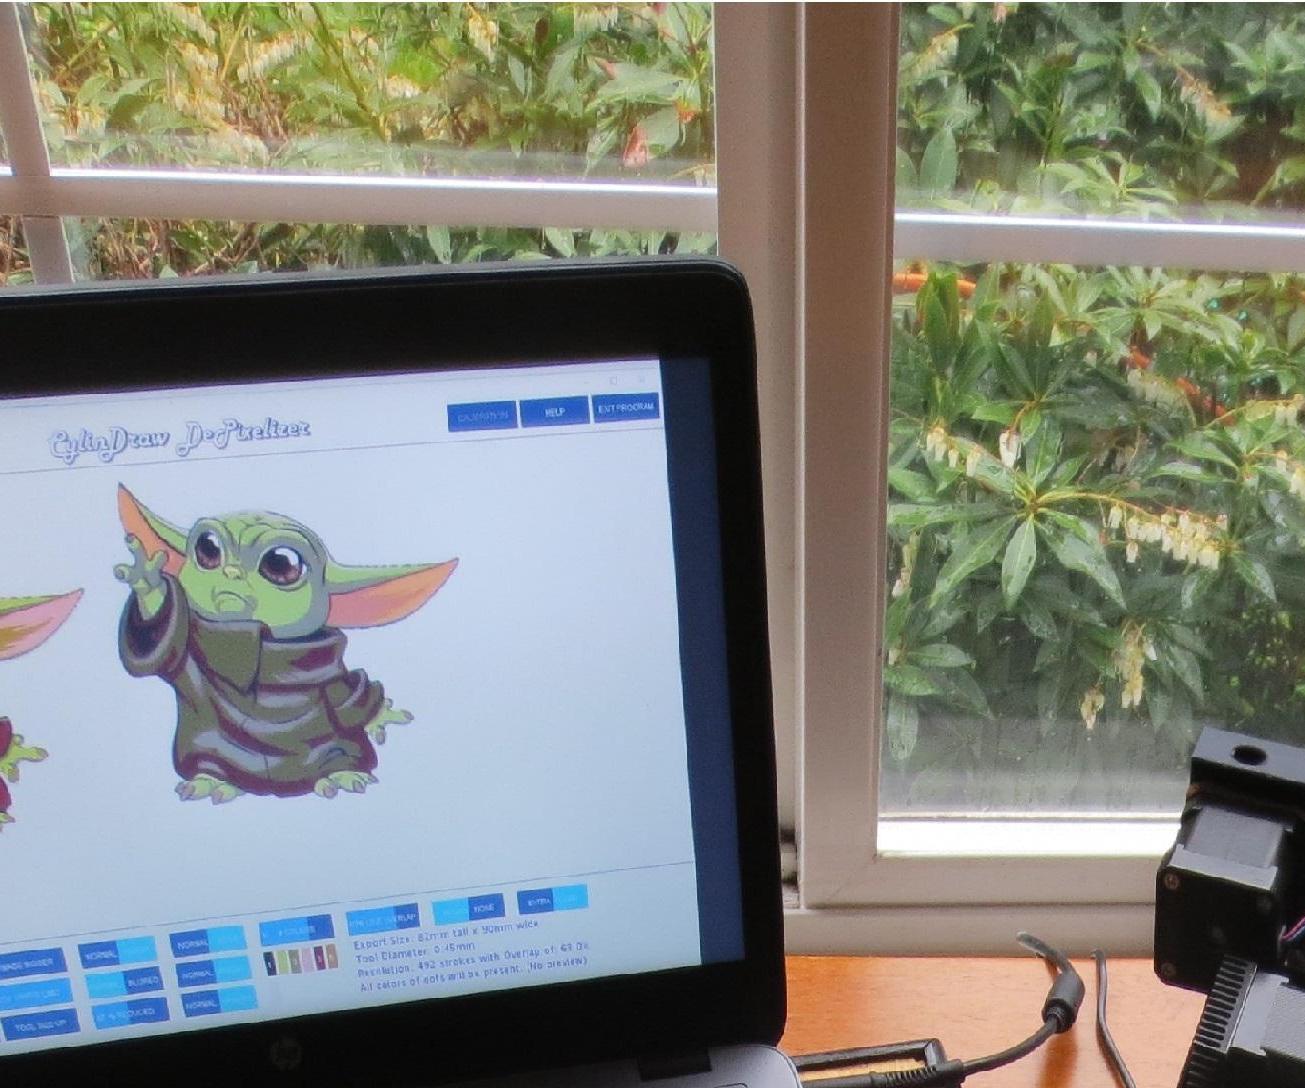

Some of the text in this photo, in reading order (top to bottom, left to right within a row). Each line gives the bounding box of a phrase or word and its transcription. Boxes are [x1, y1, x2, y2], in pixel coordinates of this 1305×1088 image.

[544, 407, 566, 418] HELP
[51, 424, 172, 466] CylinDraw
[177, 939, 209, 950] NORMAL
[354, 937, 386, 950] Export
[479, 952, 500, 963] with
[504, 948, 540, 960] Overlap
